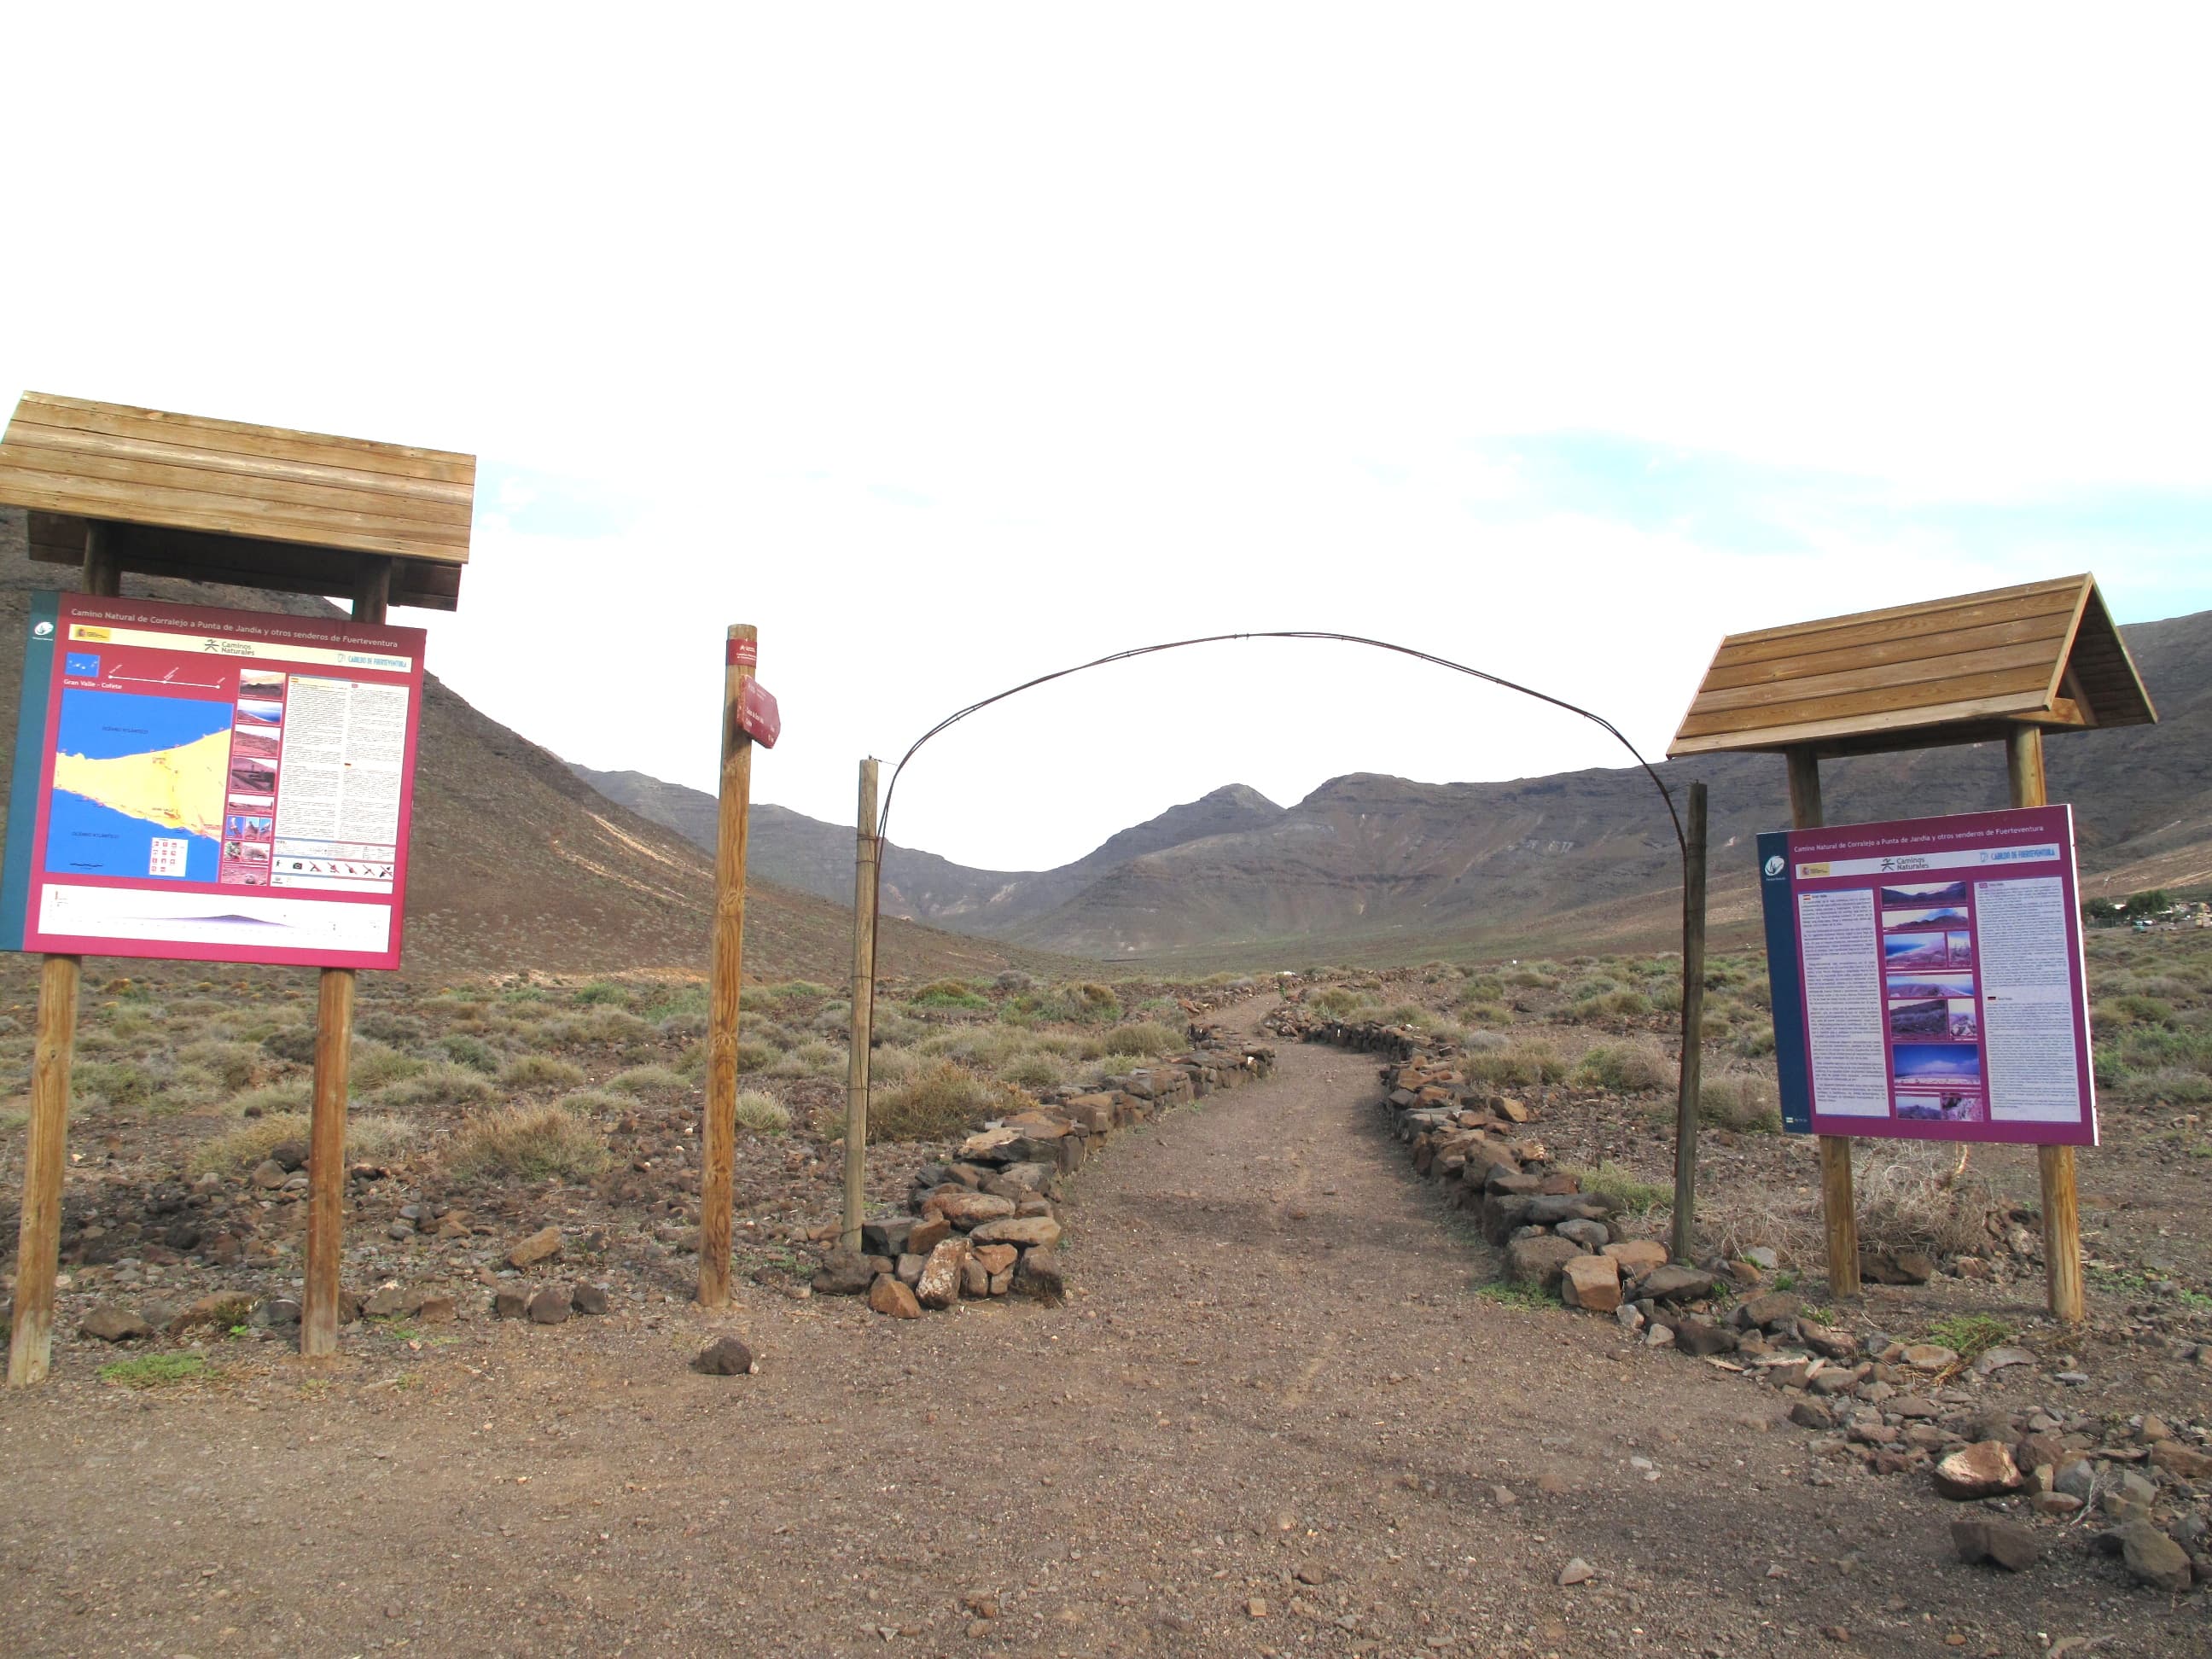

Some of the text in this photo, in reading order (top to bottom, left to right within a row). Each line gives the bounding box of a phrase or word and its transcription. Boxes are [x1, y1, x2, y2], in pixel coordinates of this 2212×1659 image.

[71, 608, 102, 619] Camino
[105, 611, 136, 621] Natural
[137, 615, 148, 624] de
[150, 616, 189, 628] Corralejo
[198, 620, 221, 631] Punta
[224, 623, 234, 632] de
[271, 629, 292, 637] otros
[294, 632, 329, 641] senderos
[330, 634, 341, 643] de
[342, 635, 399, 649] Fuerteventura
[222, 641, 252, 650] Caminos
[222, 648, 255, 656] Naturales
[1816, 842, 1837, 851] Natural
[1847, 840, 1875, 848] Corralejo
[1955, 830, 1984, 839] senderos
[1995, 825, 2044, 835] Fuerteventura
[1896, 856, 1925, 865] Caminos
[1896, 862, 1930, 870] Naturales
